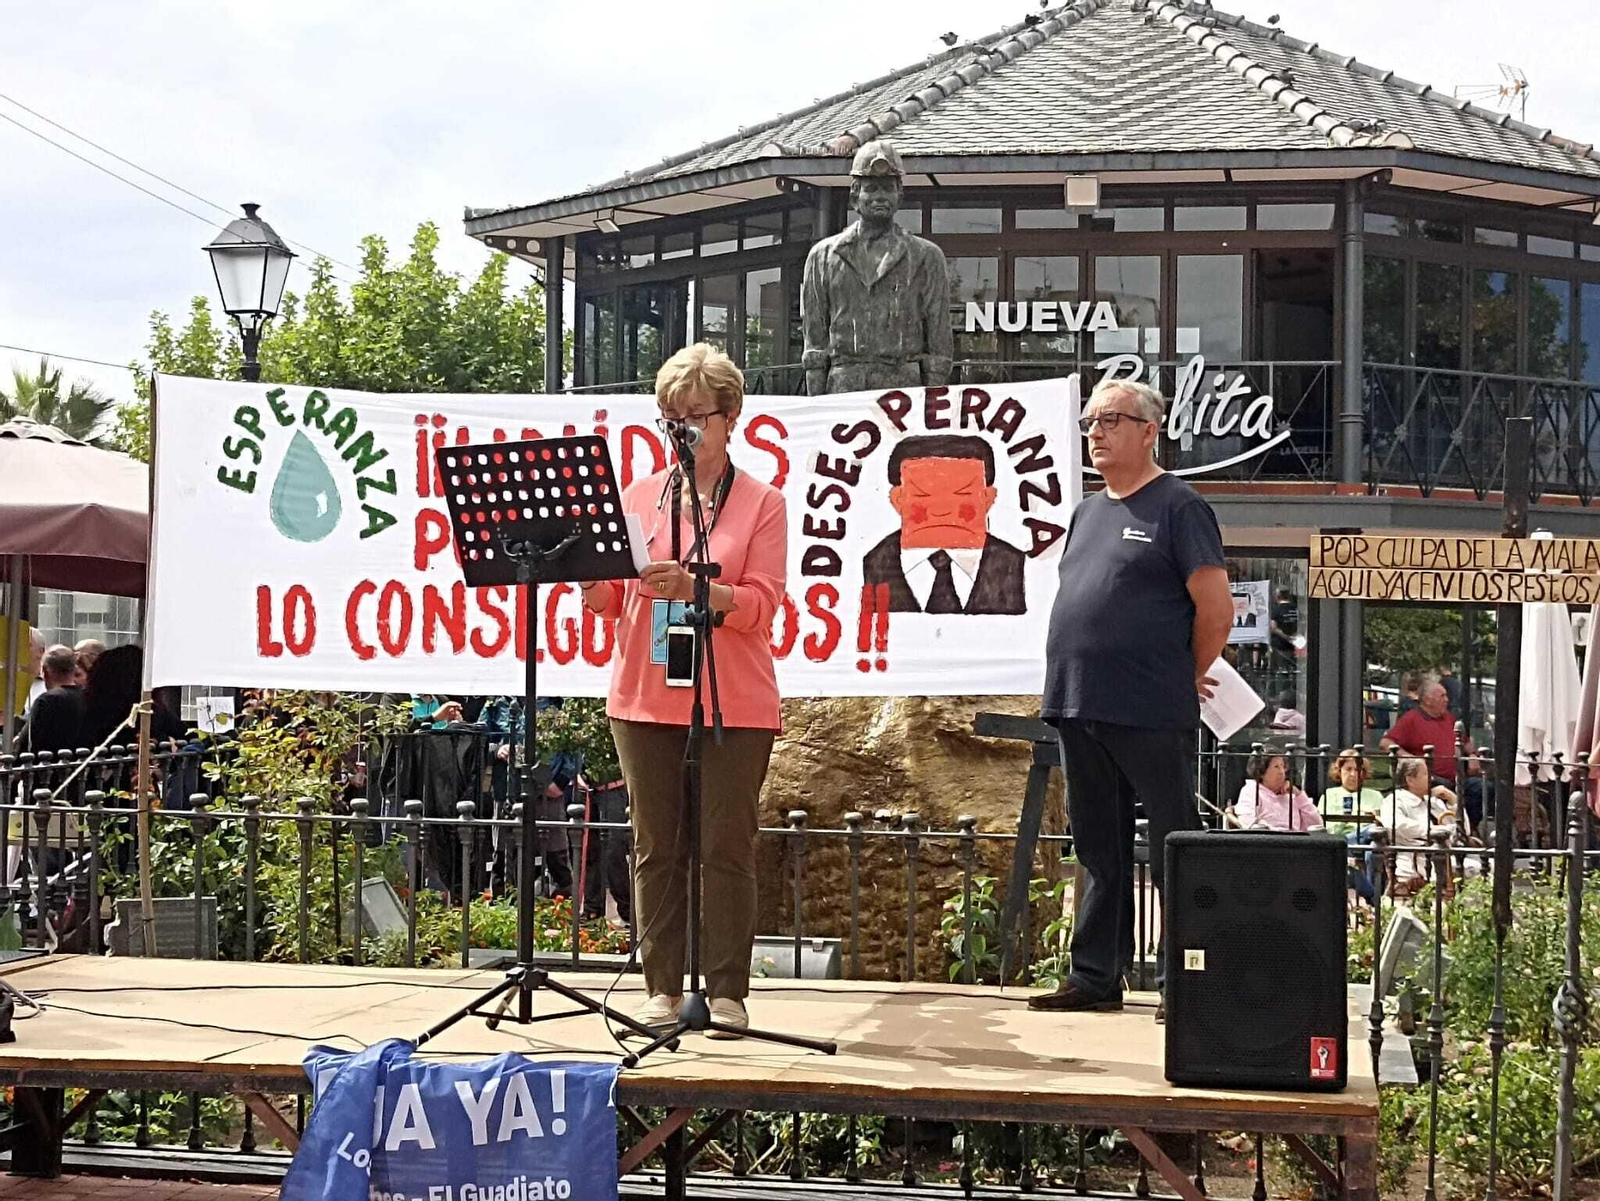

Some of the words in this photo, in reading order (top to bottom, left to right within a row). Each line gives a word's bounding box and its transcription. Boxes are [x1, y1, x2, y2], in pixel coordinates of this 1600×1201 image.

[965, 301, 1119, 332] NUEVA
[217, 387, 398, 540] ESPERANZA
[1320, 536, 1369, 567] POR
[1377, 537, 1450, 568] CULPA
[1456, 539, 1486, 568] DE
[1491, 539, 1525, 572] LA
[1530, 540, 1600, 573] MALA
[1310, 569, 1373, 598] AQUI
[1376, 570, 1455, 600] YACEN
[1459, 572, 1503, 601] LOS
[256, 584, 317, 658] LO
[455, 1070, 567, 1146] YA!
[459, 1175, 571, 1201] Guadiato
